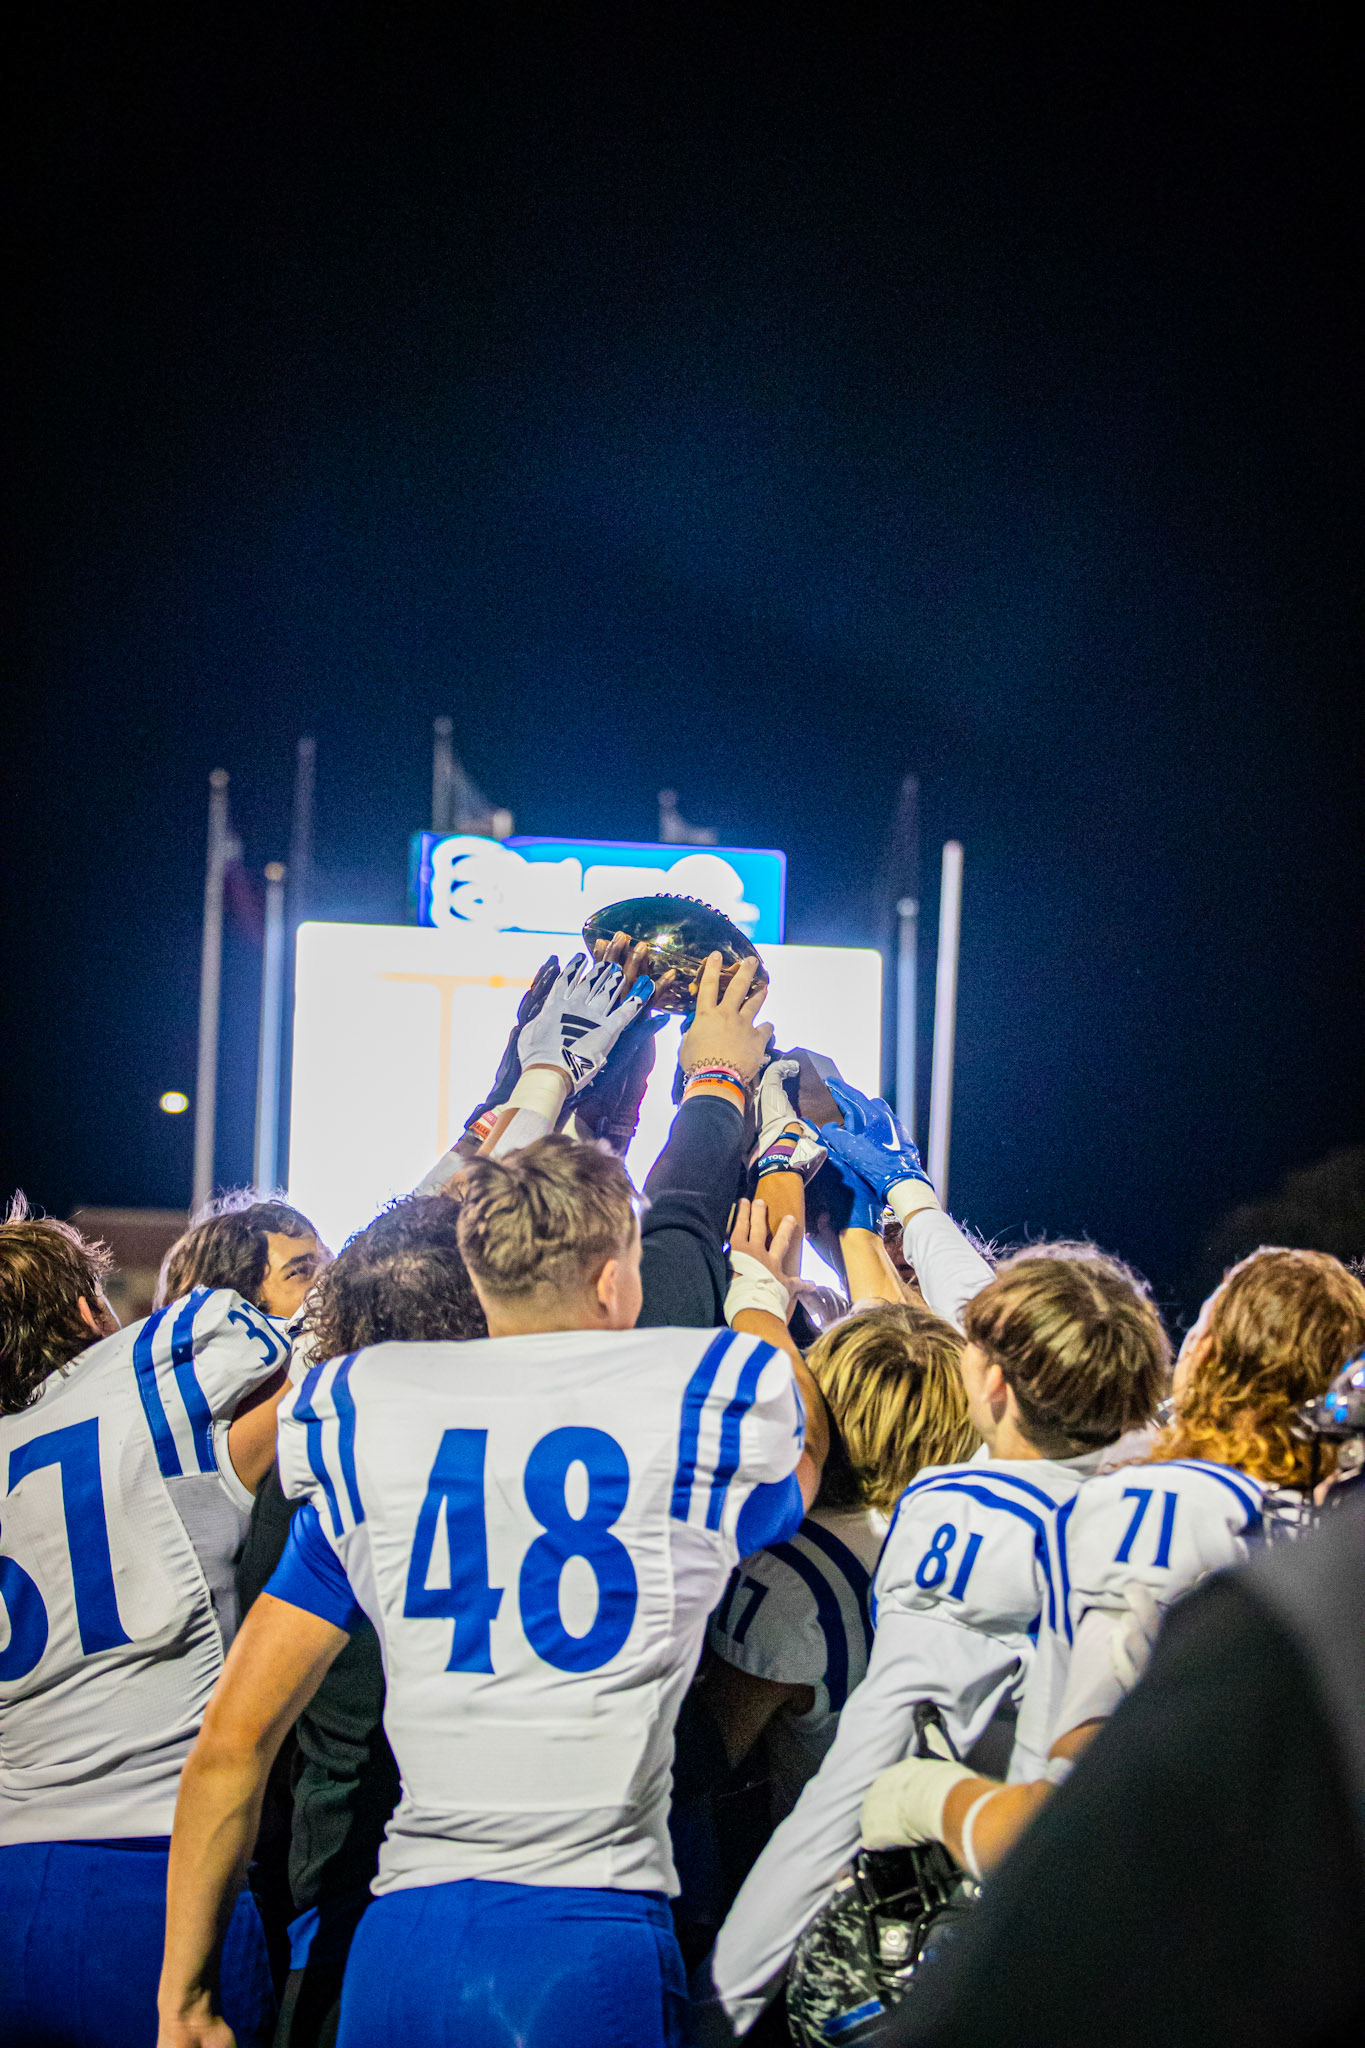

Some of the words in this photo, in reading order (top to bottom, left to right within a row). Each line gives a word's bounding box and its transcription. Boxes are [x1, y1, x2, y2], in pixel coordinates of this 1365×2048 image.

[403, 1426, 638, 1675] 48
[915, 1523, 984, 1602] 81
[1113, 1487, 1179, 1568] 71
